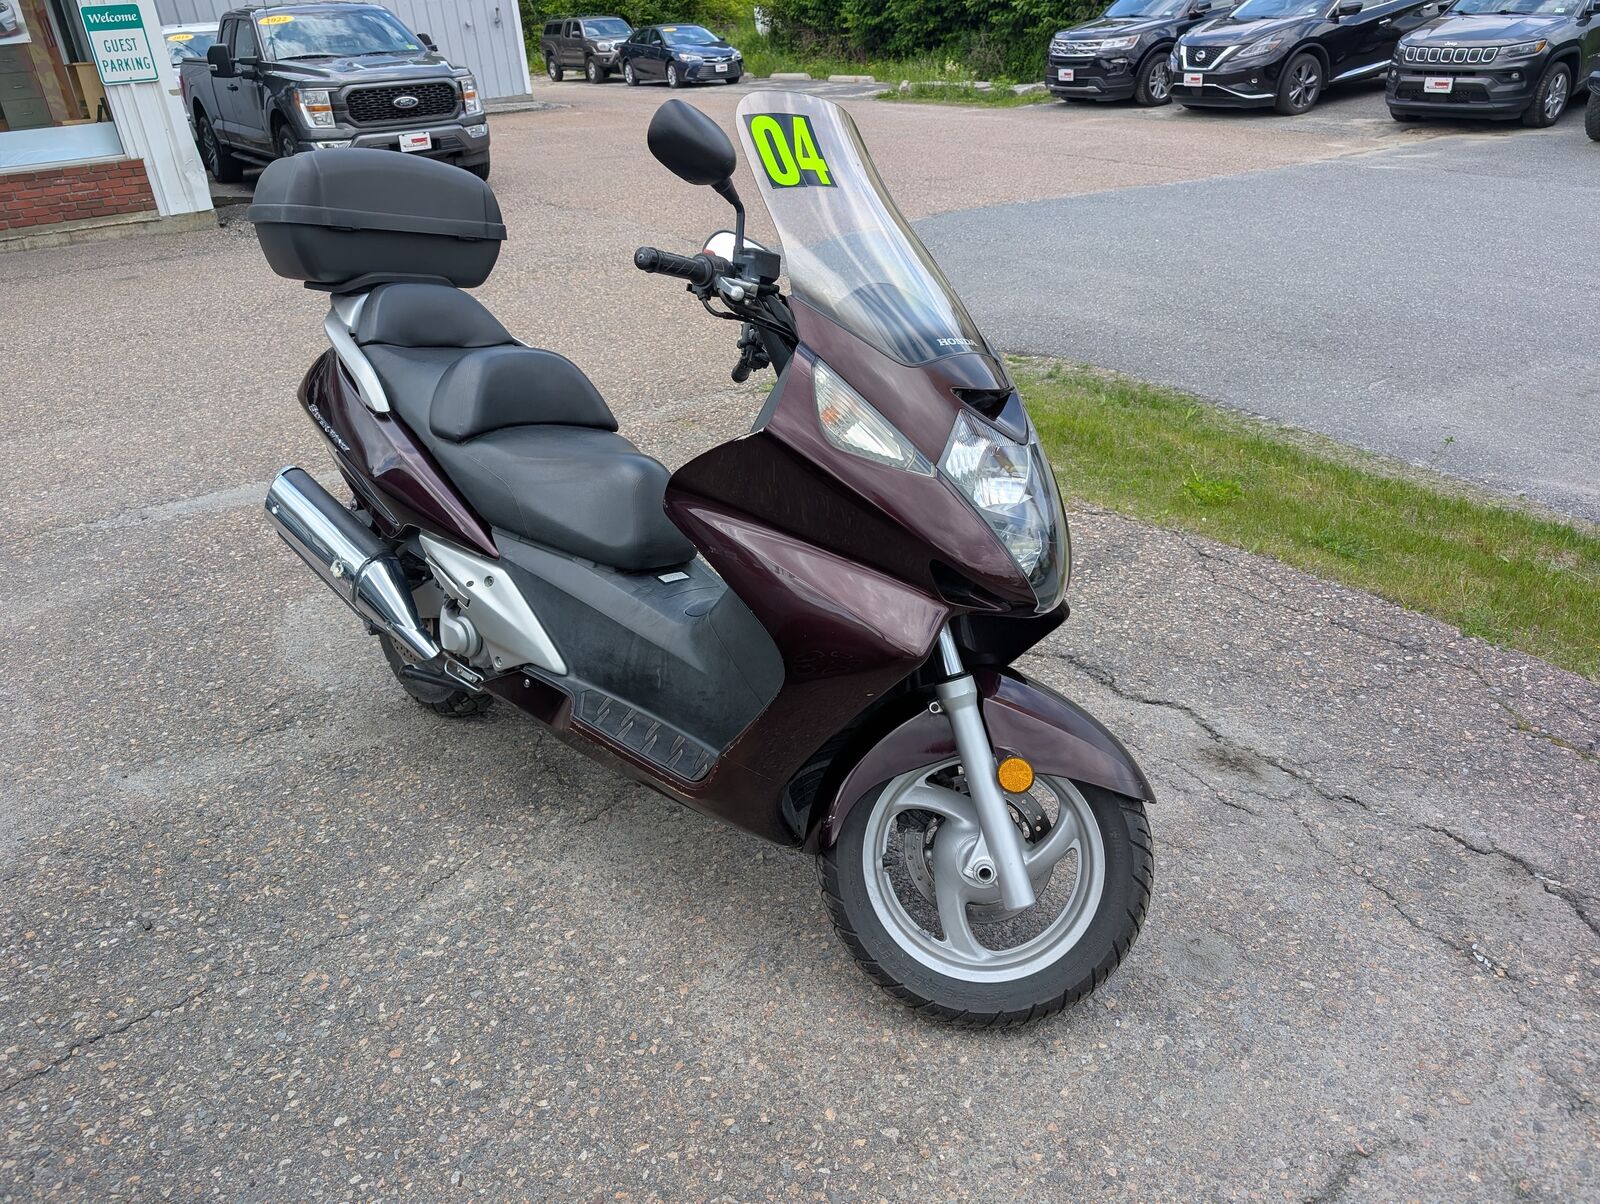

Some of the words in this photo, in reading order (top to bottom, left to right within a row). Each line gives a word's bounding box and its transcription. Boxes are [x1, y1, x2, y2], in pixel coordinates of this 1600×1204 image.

[87, 11, 138, 24] Welcome
[103, 38, 138, 53] GUEST
[102, 56, 151, 73] PARKING
[751, 115, 831, 186] 04
[936, 337, 980, 347] HONDA
